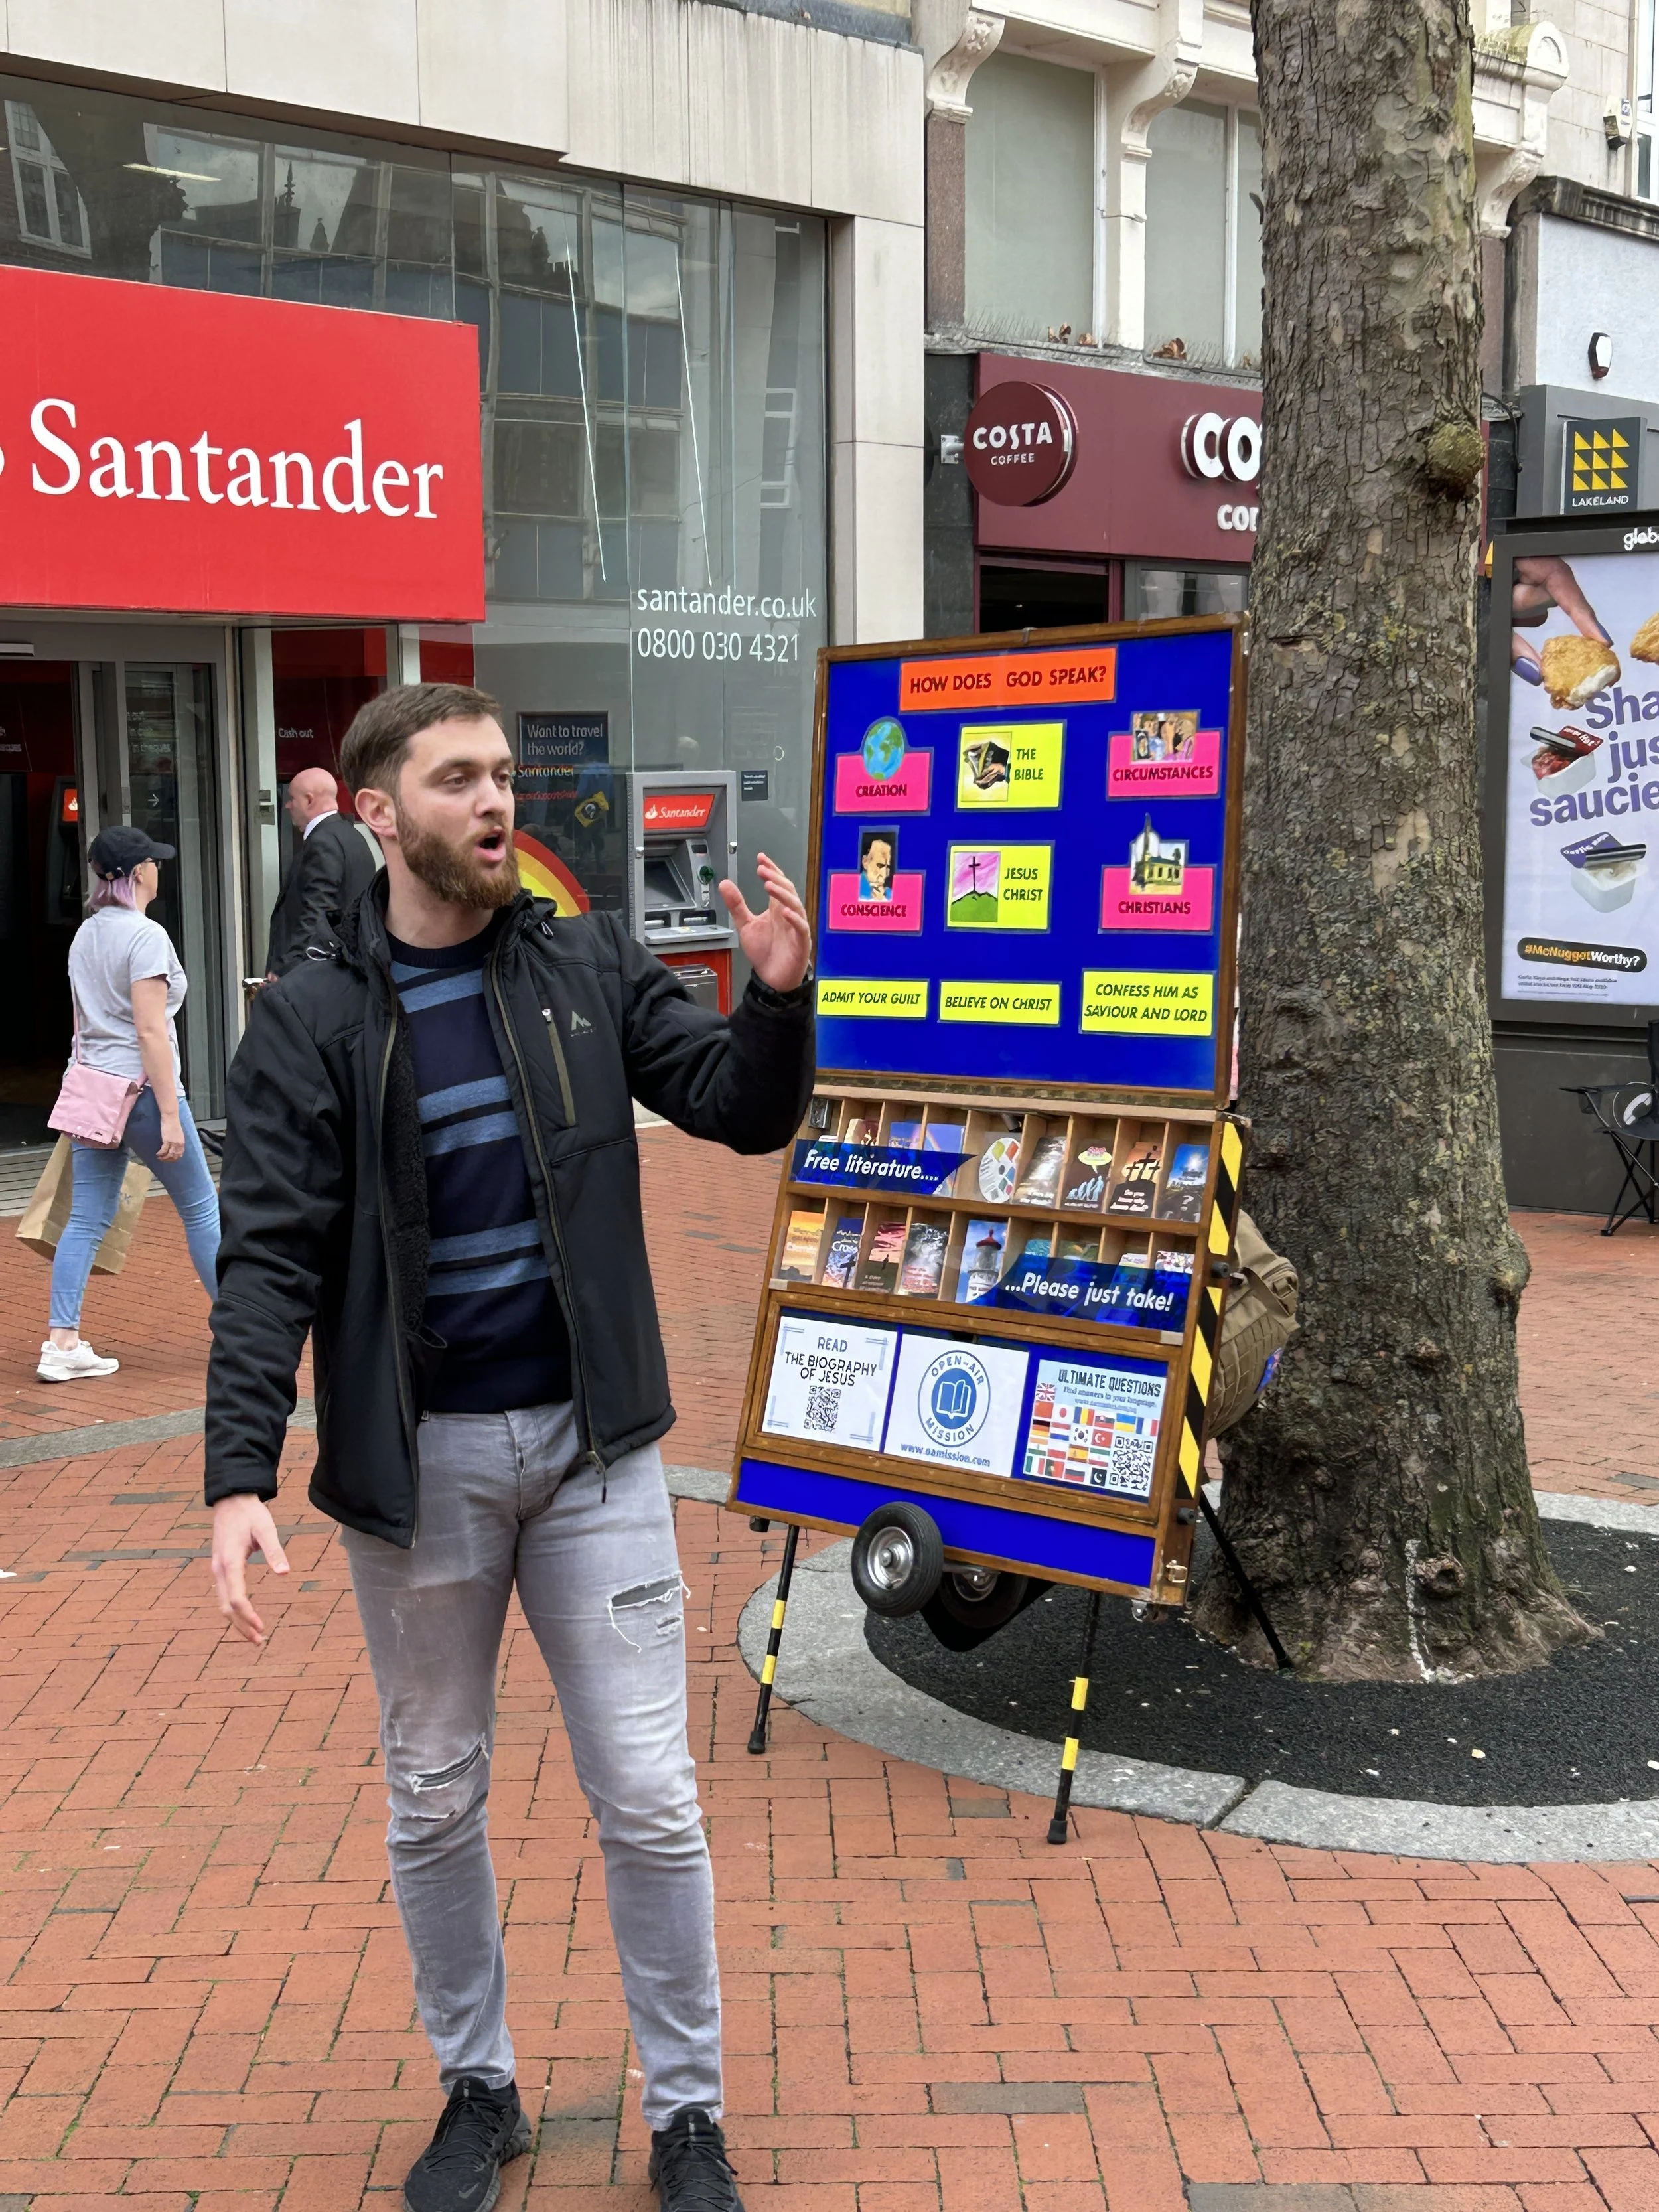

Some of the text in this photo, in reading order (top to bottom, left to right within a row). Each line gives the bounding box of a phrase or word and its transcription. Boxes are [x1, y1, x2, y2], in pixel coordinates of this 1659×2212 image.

[973, 421, 1052, 450] COSTA
[1181, 412, 1262, 482] CO
[30, 398, 443, 518] Santander
[991, 453, 1035, 465] COFFEE
[1572, 496, 1629, 507] LAKELAND
[1623, 526, 1659, 551] glob
[637, 585, 817, 618] santander.co.uk
[638, 628, 799, 662] 0800 030 4321
[910, 665, 1107, 694] HOW DOES GOD SPEAK?
[1585, 687, 1659, 729] Sha
[527, 723, 603, 738] Want to travel
[527, 741, 585, 755] the world?
[1016, 747, 1037, 761] THE
[1014, 767, 1044, 781] BIBLE
[1112, 765, 1214, 782] CIRCUMSTANCES
[855, 784, 907, 798] CREATION
[659, 804, 706, 819] Santander
[1004, 867, 1039, 881] JESUS
[1003, 888, 1044, 901] CHRIST
[841, 904, 907, 917] CONSCIENCE
[1118, 901, 1191, 915] CHRISTIANS
[822, 992, 921, 1005] ADMIT YOUR GUILT
[1096, 984, 1199, 999] CONFESS HIM AS
[945, 996, 1052, 1010] BELIEVE ON CHRIST
[1084, 1005, 1208, 1021] SAVIOUR AND LORD
[804, 1149, 839, 1171] Free
[1005, 1272, 1174, 1311] ...Please just take!
[817, 1336, 848, 1353] READ
[785, 1351, 877, 1376] THE BIOGRAPHY
[931, 1355, 985, 1385] OPEN-AIR
[800, 1367, 856, 1386] OF JESUS
[1058, 1369, 1161, 1397] ULTIMATE QUESTIONS
[925, 1417, 974, 1441] MISSION
